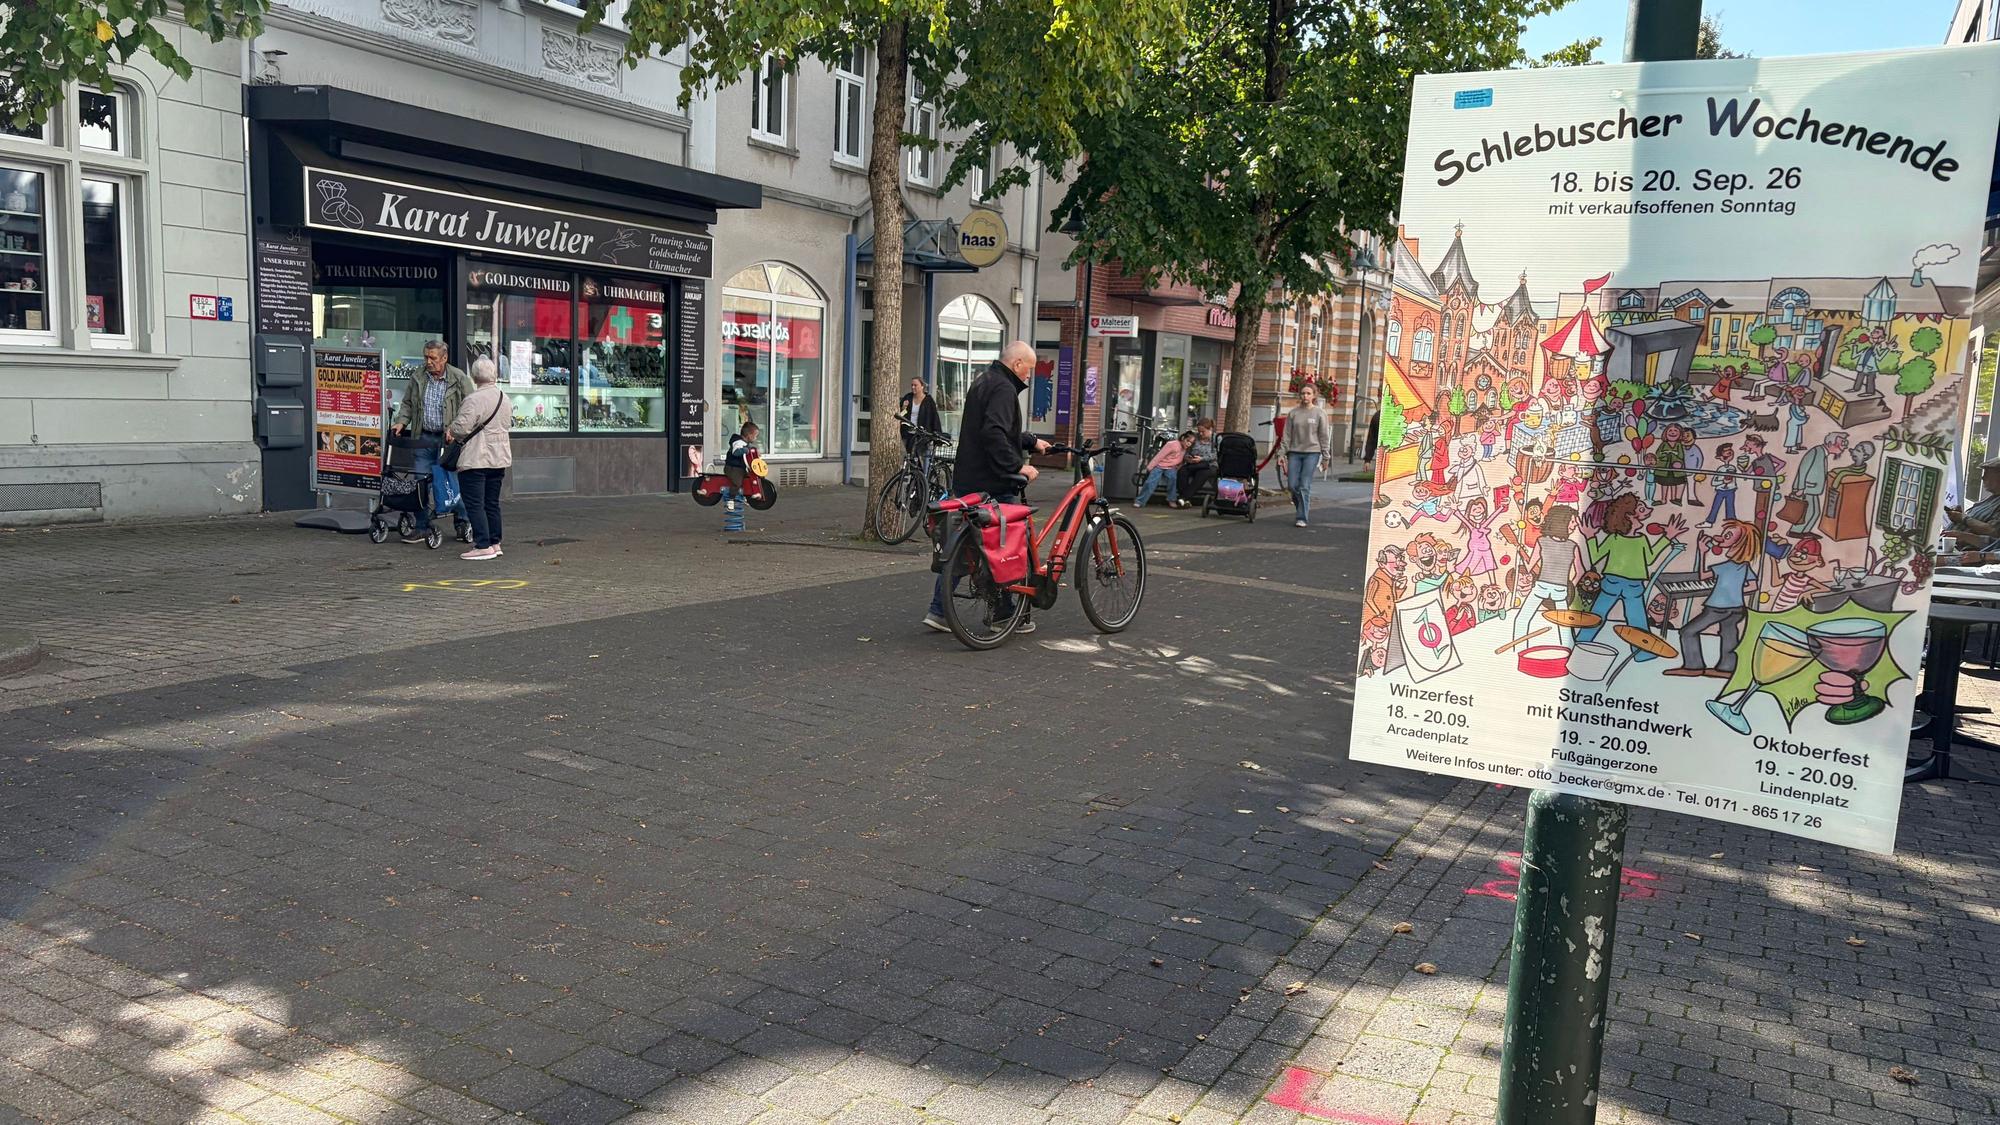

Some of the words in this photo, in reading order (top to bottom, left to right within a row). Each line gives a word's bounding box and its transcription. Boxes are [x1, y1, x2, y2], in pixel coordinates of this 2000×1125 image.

[1434, 107, 1683, 188] Schlebuscher
[1706, 96, 1960, 183] Wochenende
[1550, 172, 1583, 194] 18.
[1594, 168, 1633, 193] bis
[1642, 169, 1681, 193] 20.
[1693, 168, 1754, 196] Sep.
[1766, 167, 1801, 190] 26
[1548, 201, 1574, 215] mit
[1579, 199, 1714, 216] verkaufsoffenen
[1720, 198, 1797, 216] Sonntag
[376, 191, 470, 238] Karat
[475, 209, 595, 255] Juwelier
[649, 233, 684, 250] Trauring
[684, 239, 709, 251] Studio
[961, 232, 996, 247] haas
[263, 257, 282, 265] UNSER
[283, 259, 307, 267] SERVICE
[648, 246, 702, 263] Goldschmiede
[325, 265, 438, 280] TRAURINGSTUDIO
[648, 259, 692, 274] Uhrmacher
[485, 271, 570, 292] GOLDSCHMIED
[603, 285, 665, 303] UHRMACHER
[1101, 318, 1130, 326] Malteser
[324, 353, 342, 362] Karat
[342, 354, 368, 363] Juwelier
[317, 369, 336, 381] GOLD
[336, 370, 363, 384] ANKAUF
[1389, 683, 1474, 707] Winzerfest
[1558, 687, 1659, 714] Straßenfest
[1386, 704, 1407, 719] 18.
[1424, 709, 1470, 728] 20.09.
[1527, 703, 1552, 719] mit
[1556, 706, 1693, 738] Kunsthandwerk
[1387, 723, 1469, 746] Arcadenplatz
[1559, 730, 1582, 745] 19.
[1599, 736, 1651, 756] 20.09.
[1551, 748, 1658, 774] Fußgängerzone
[1752, 735, 1870, 768] Oktoberfest
[1754, 759, 1780, 776] 19.
[1800, 767, 1858, 791] 20.09.
[1406, 748, 1451, 766] Weitere
[1454, 753, 1485, 771] Infos
[1488, 762, 1523, 777] unter:
[1528, 767, 1665, 798] otto_becker@gmx.de
[1676, 790, 1700, 805] Tel.
[1705, 796, 1737, 812] 0171
[1752, 804, 1779, 820] 865
[1782, 810, 1800, 824] 17
[1804, 814, 1822, 829] 26
[1760, 781, 1849, 809] Lindenplatz
